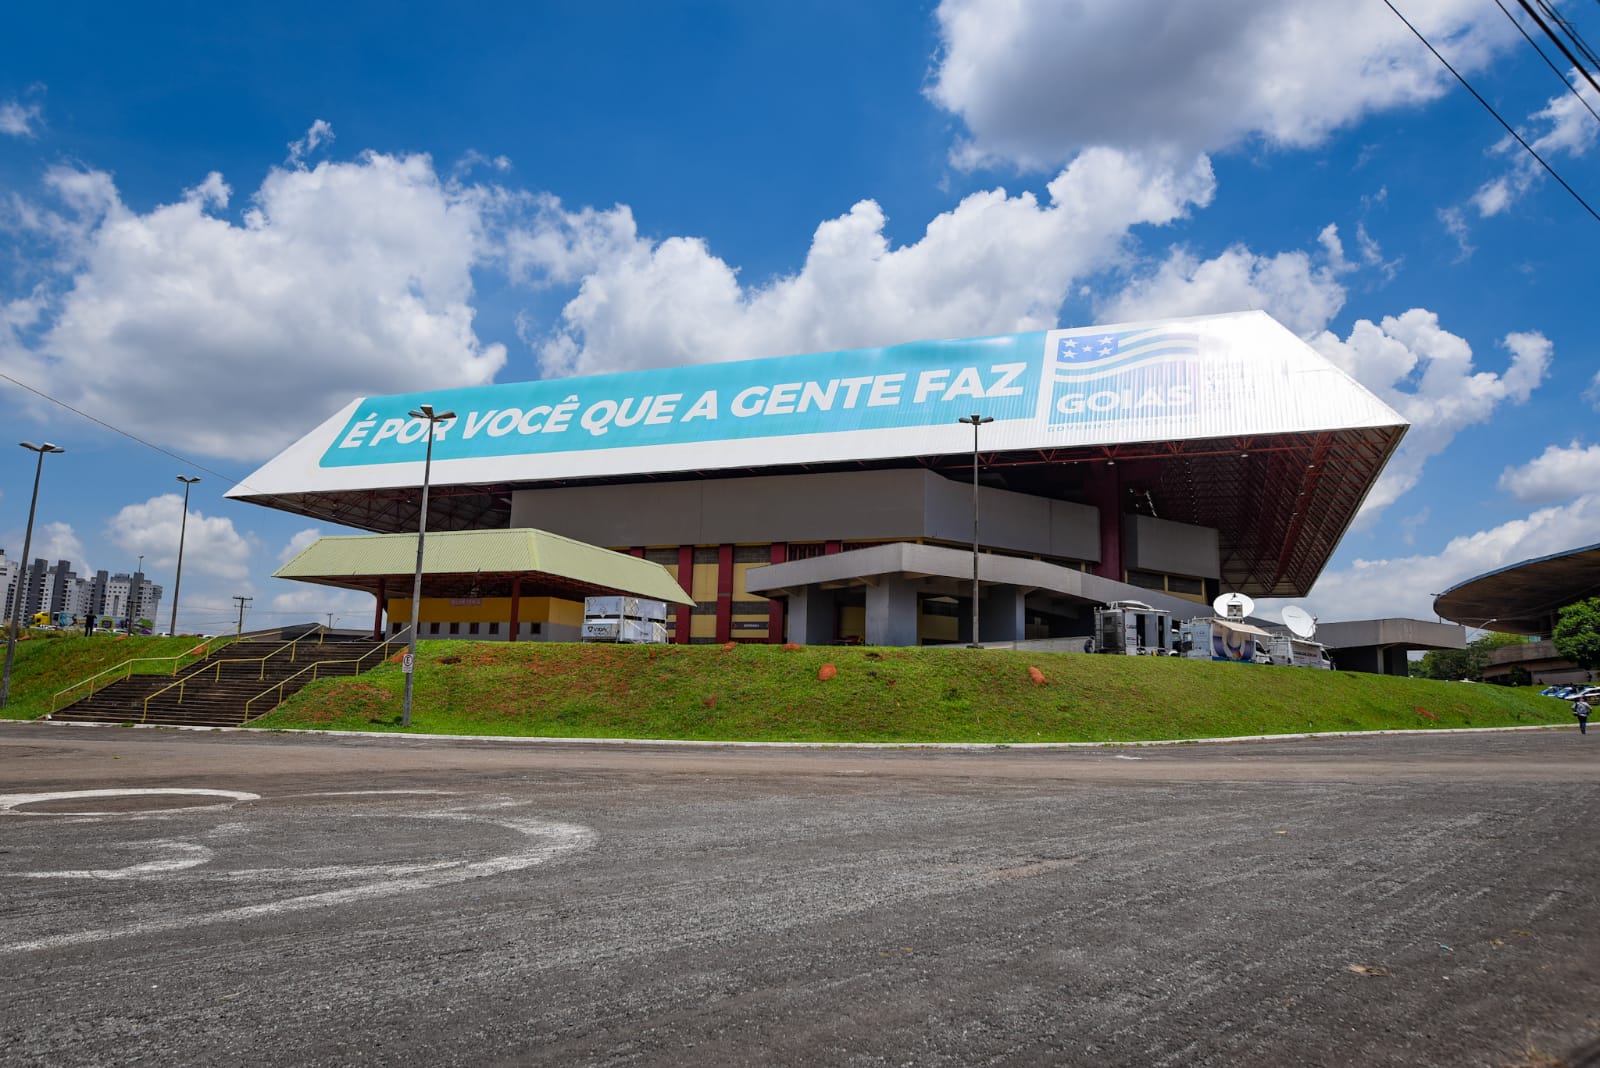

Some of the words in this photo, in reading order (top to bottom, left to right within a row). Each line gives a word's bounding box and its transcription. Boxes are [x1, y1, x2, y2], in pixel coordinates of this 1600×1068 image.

[338, 411, 377, 449] É
[462, 394, 580, 440] VOCÊ
[580, 393, 683, 436] QUE
[681, 390, 718, 423] A
[730, 373, 906, 418] GENTE
[913, 362, 1027, 403] FAZ
